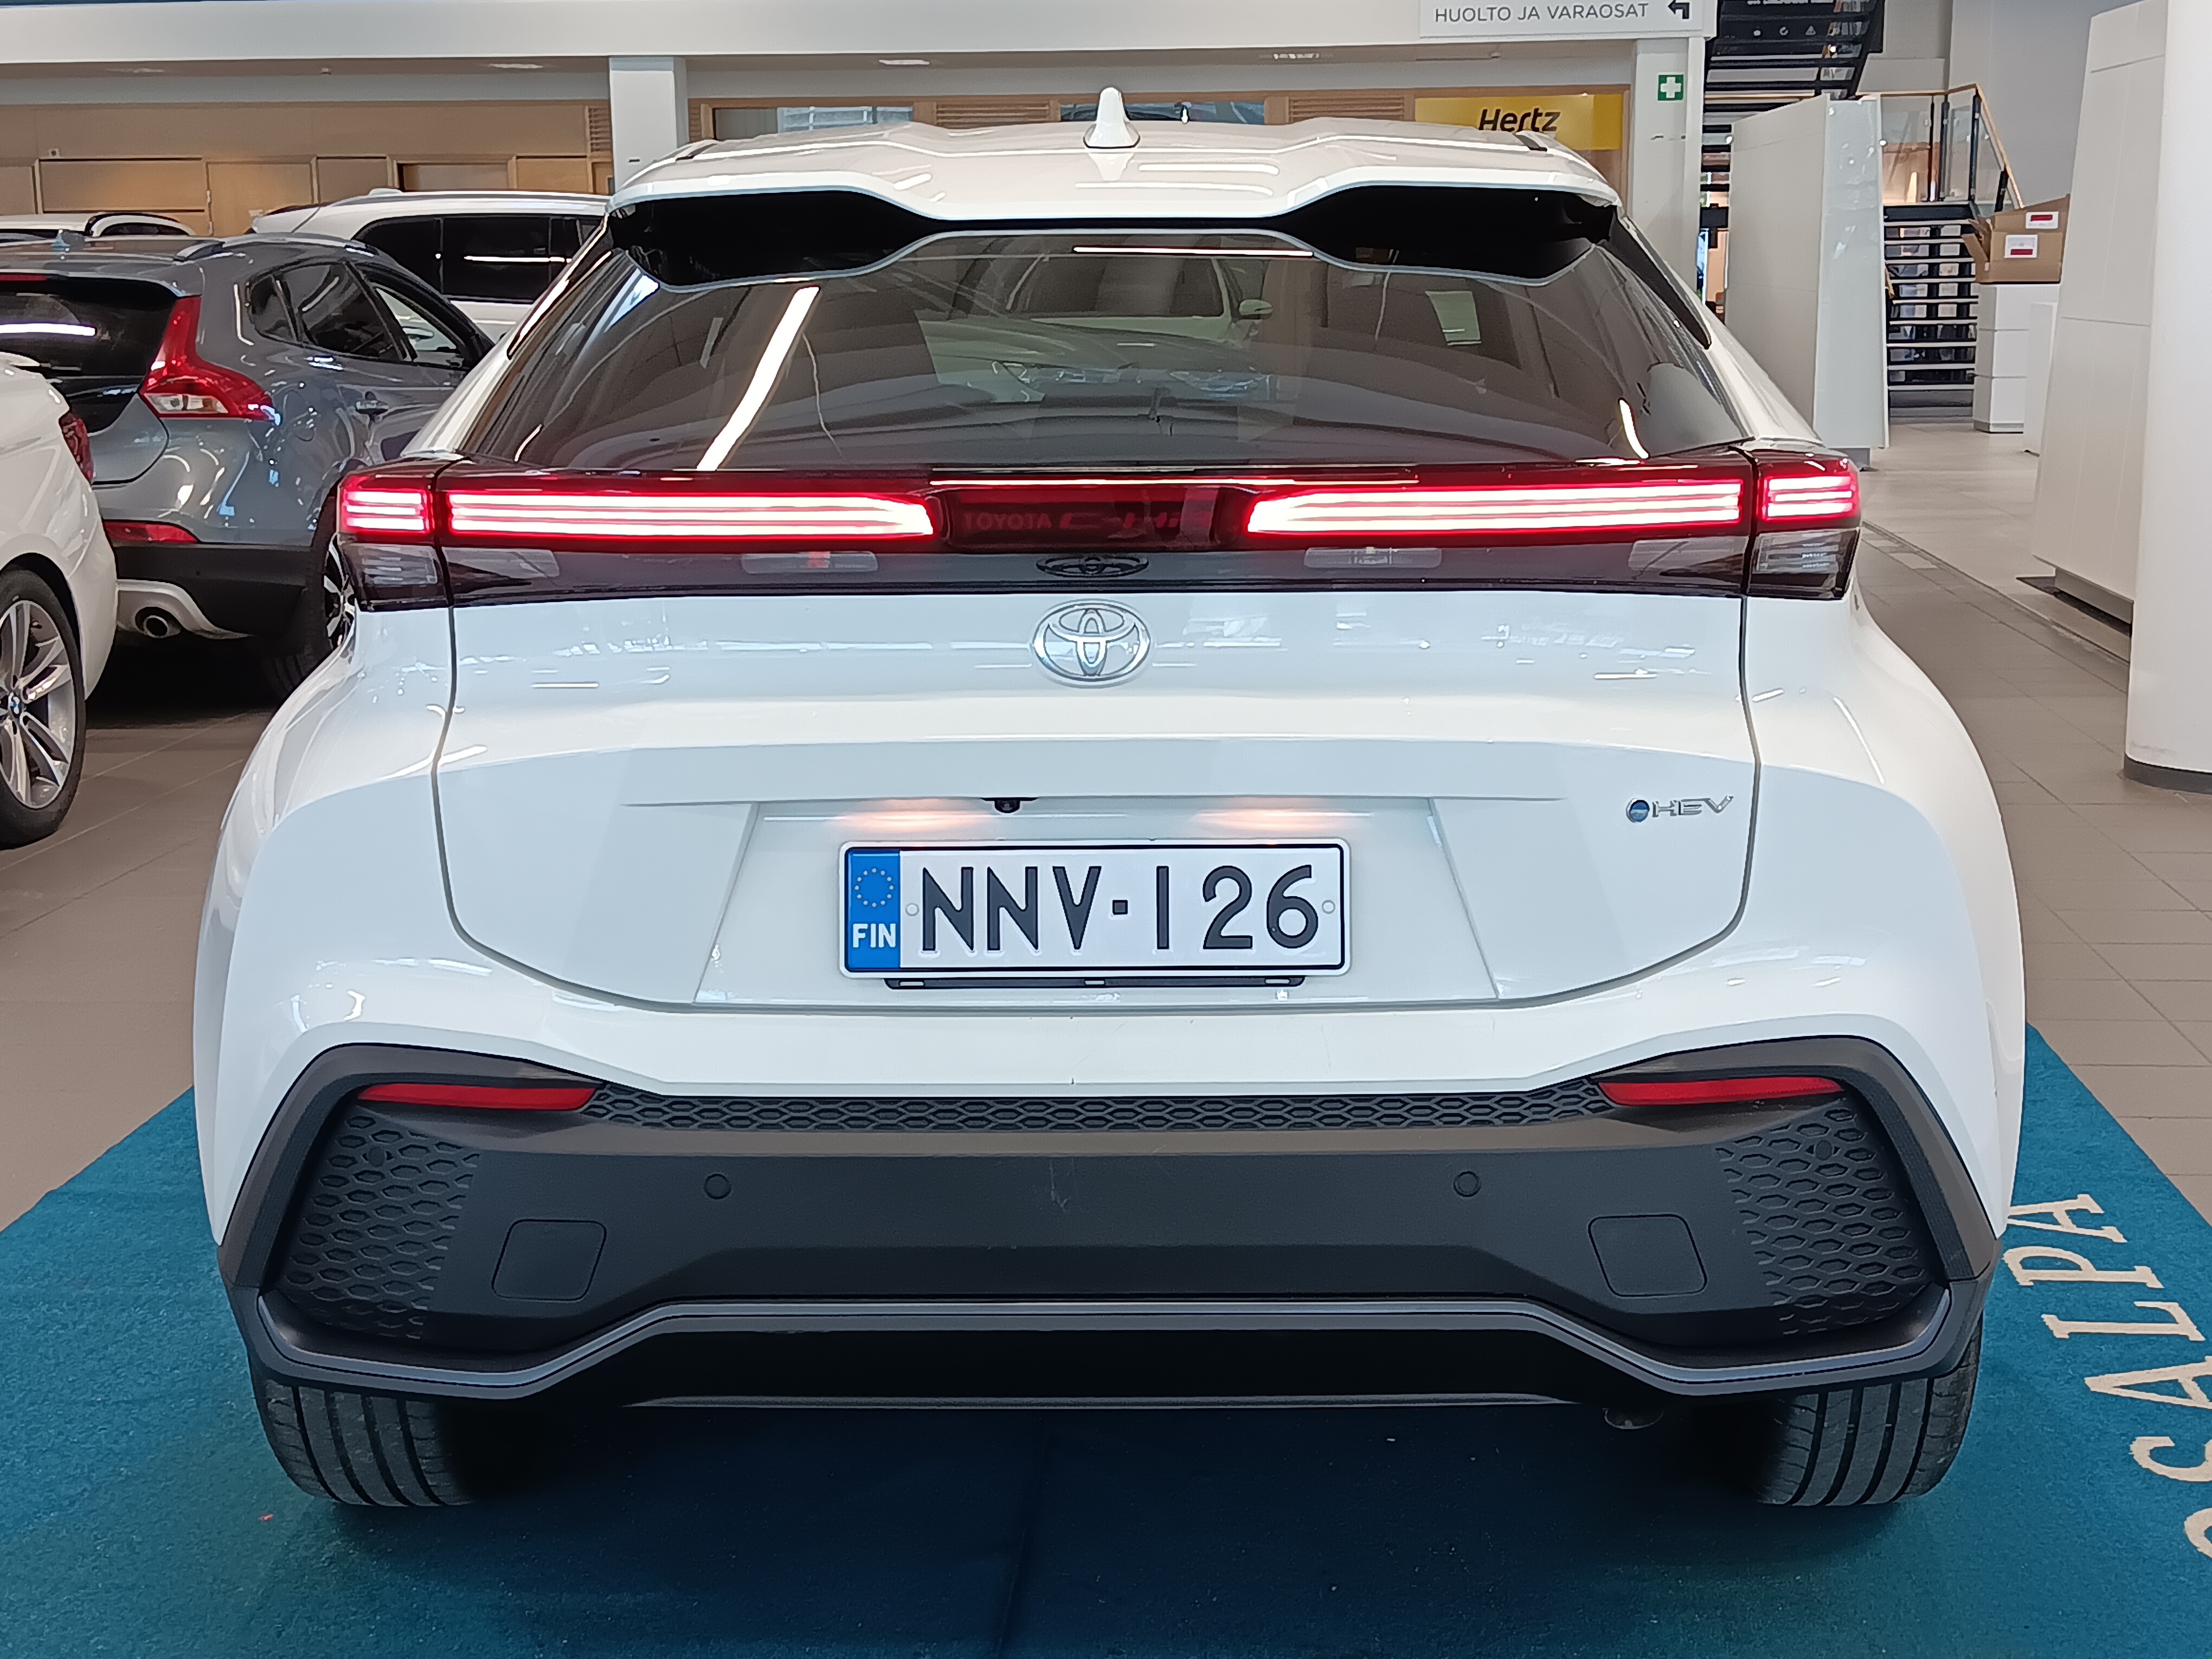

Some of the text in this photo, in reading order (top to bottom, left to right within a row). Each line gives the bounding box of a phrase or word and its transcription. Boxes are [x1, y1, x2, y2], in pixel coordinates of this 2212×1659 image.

[1435, 3, 1649, 23] HUOLTO JA VARAOSAT
[1478, 107, 1561, 133] Hertz
[963, 512, 1052, 530] TOYOTA
[1651, 795, 1734, 818] HEV
[922, 864, 1319, 951] NNV-126
[852, 923, 897, 949] FIN
[2002, 1193, 2212, 1560] SALPA
